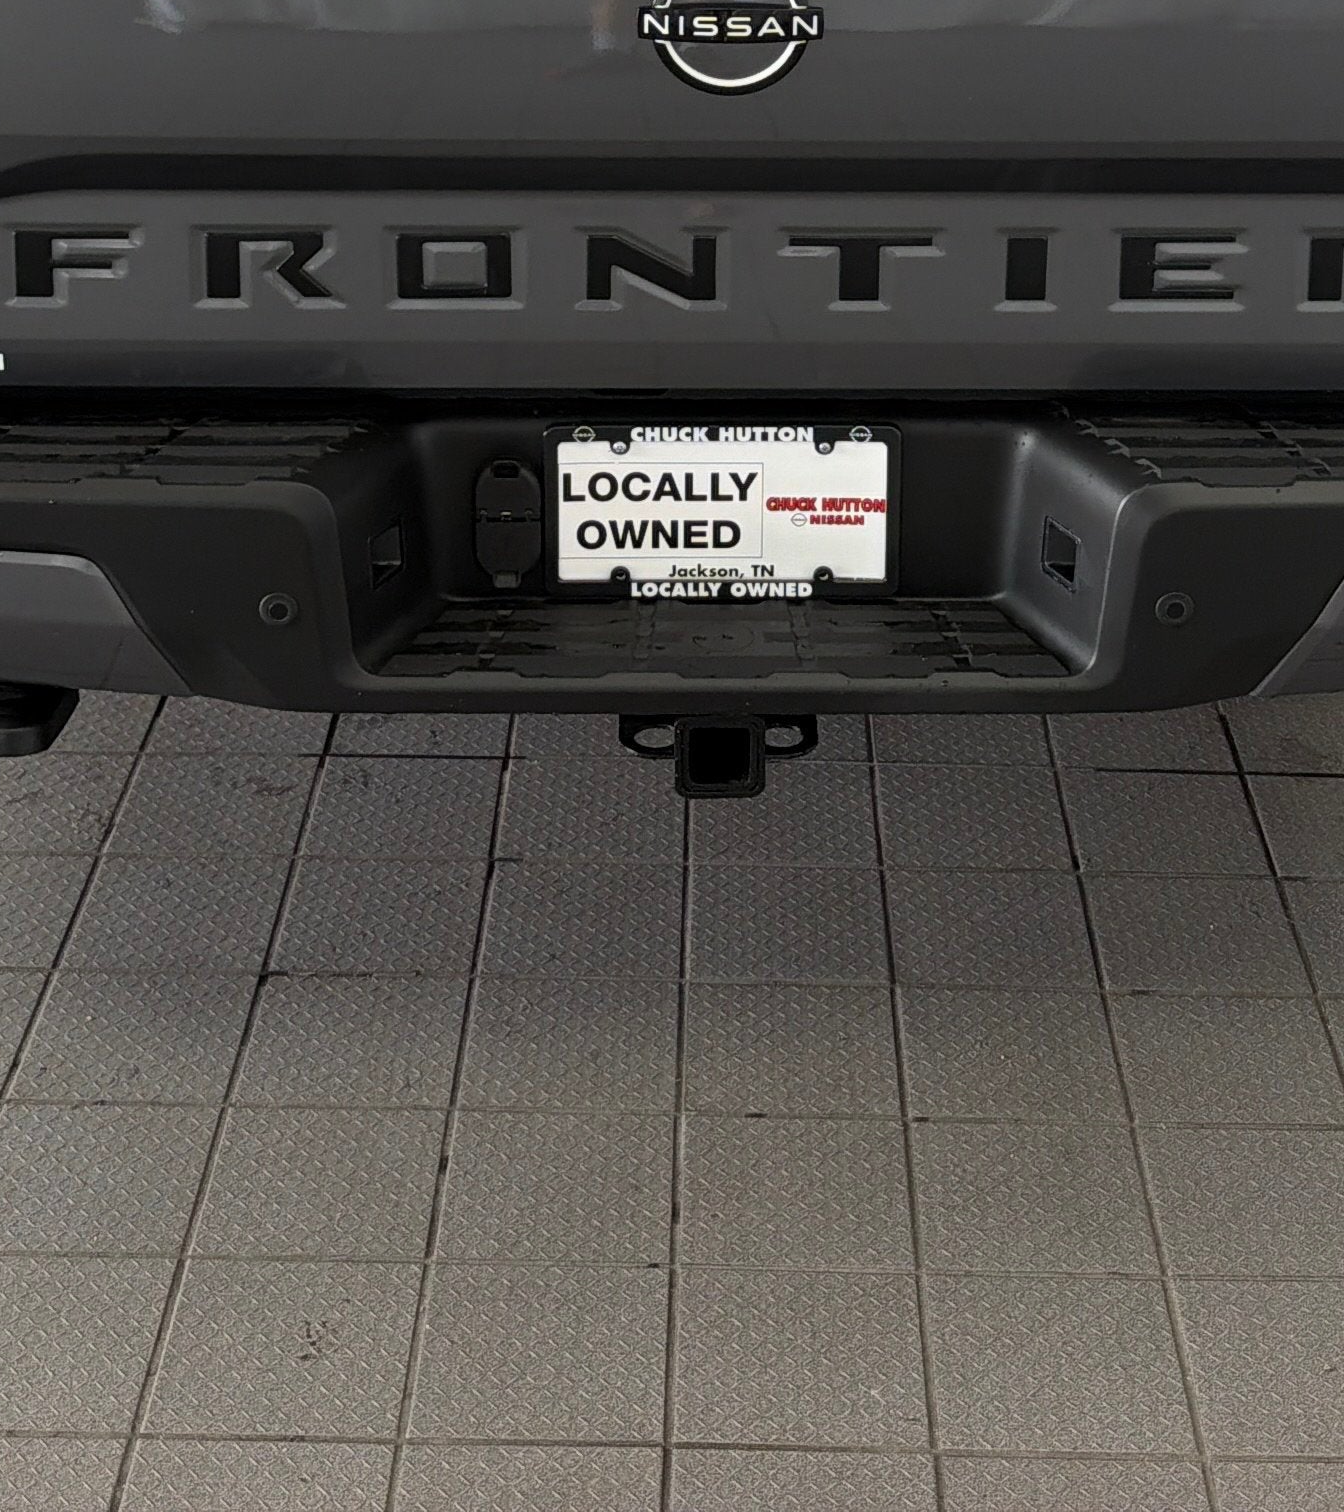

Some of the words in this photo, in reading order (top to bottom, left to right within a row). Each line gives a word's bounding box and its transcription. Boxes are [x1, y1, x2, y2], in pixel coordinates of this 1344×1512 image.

[643, 14, 819, 37] NISSAN
[630, 427, 709, 442] CHUCK
[719, 427, 814, 442] HUTTON
[562, 472, 758, 502] LOCALLY
[766, 497, 817, 512] CHUCK
[822, 498, 886, 513] HUTTON
[810, 515, 864, 525] NISSAN
[576, 519, 741, 550] OWNED
[668, 564, 744, 579] Jackson,
[751, 565, 775, 578] TN
[630, 582, 722, 598] LOCALLY
[731, 582, 813, 598] OWNED
